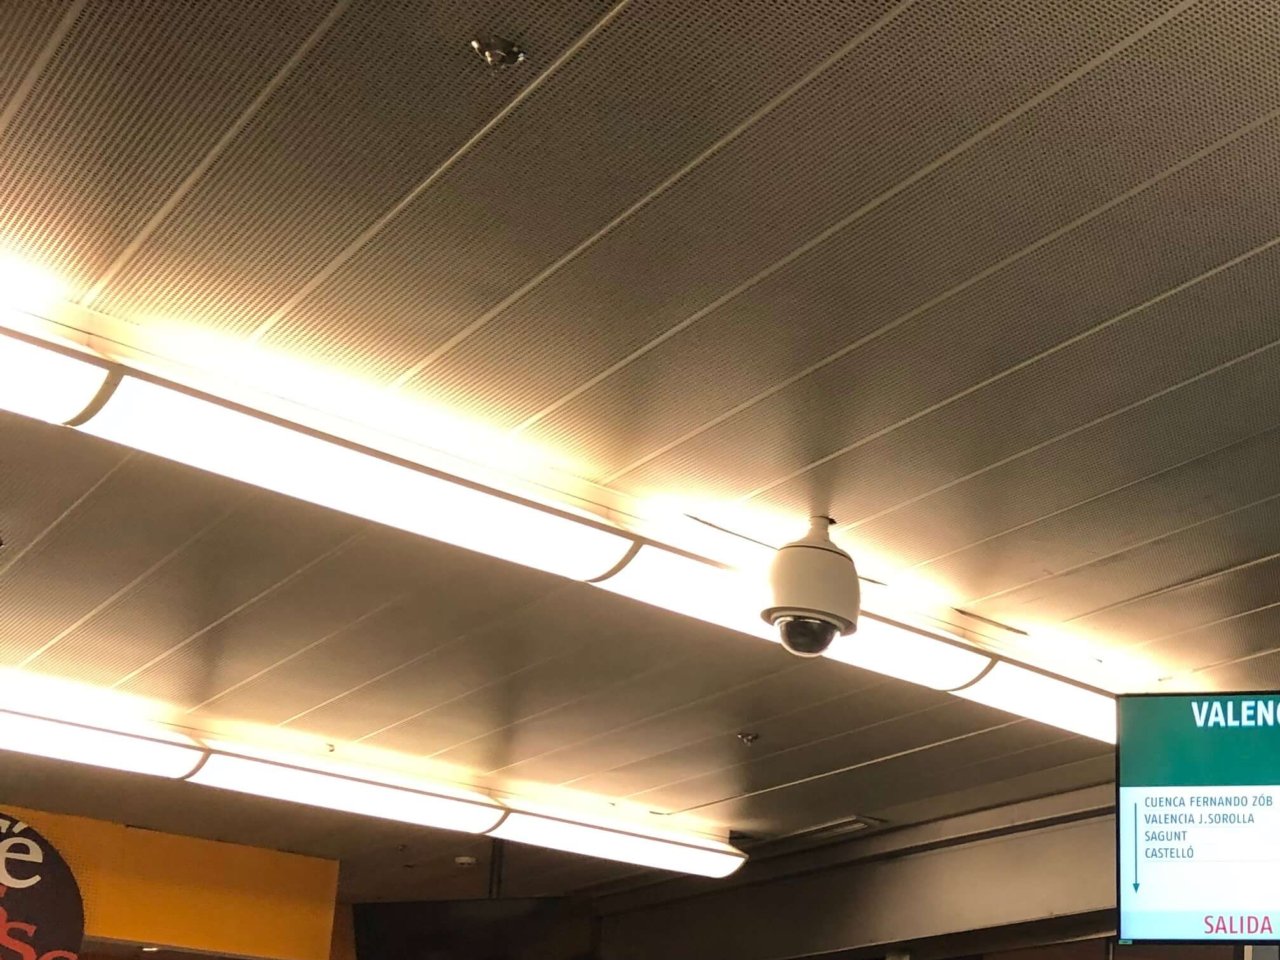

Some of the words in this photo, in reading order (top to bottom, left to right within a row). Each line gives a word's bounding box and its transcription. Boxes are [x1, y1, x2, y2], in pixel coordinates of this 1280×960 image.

[1144, 796, 1186, 808] CUENCA
[1189, 795, 1249, 807] FERNANDO
[1251, 793, 1273, 807] ZÓB
[1144, 813, 1195, 825] VALENCIA
[1198, 812, 1255, 825] J.SOROLLA
[1144, 830, 1187, 842] SAGUNT
[1144, 845, 1194, 859] CASTELLÓ
[1203, 915, 1274, 935] SALIDA
